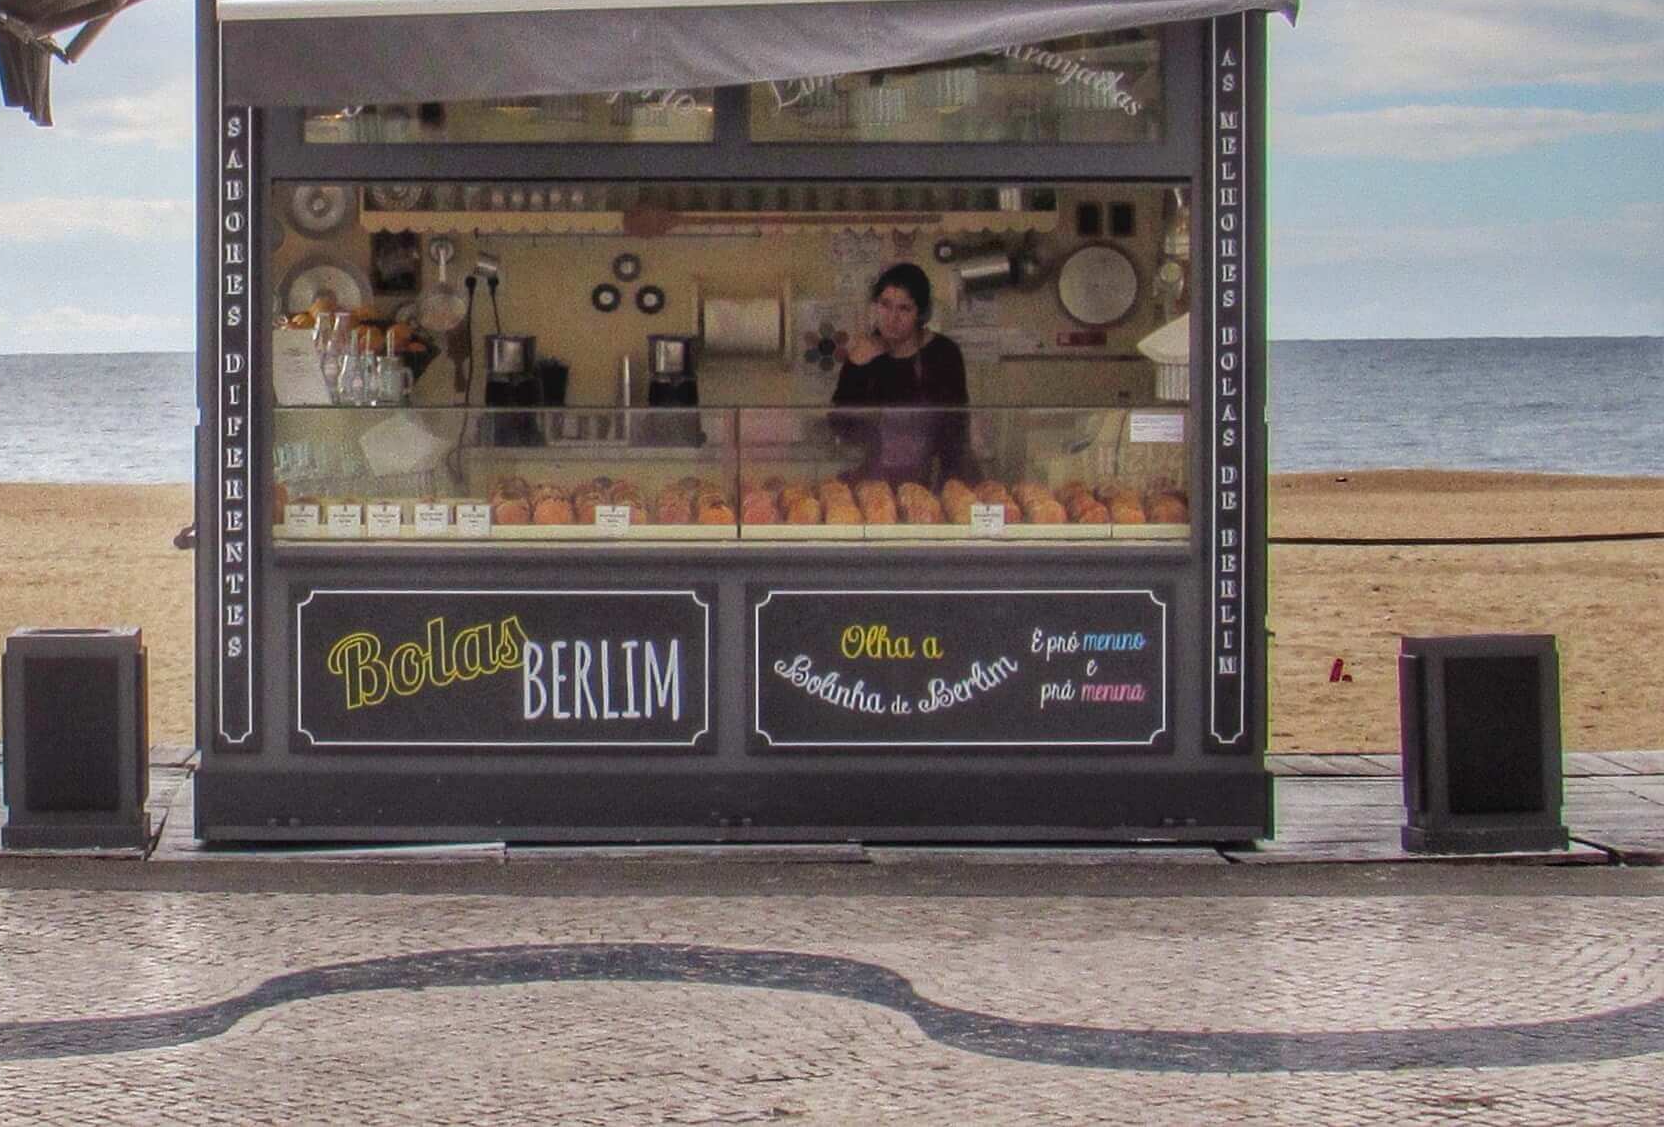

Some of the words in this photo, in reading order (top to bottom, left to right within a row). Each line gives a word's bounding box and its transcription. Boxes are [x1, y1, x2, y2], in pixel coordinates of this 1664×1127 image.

[1219, 48, 1237, 92] AS
[224, 115, 245, 327] SABORES
[1219, 110, 1238, 308] MELHORES
[1219, 326, 1238, 447] BOLAS
[224, 352, 245, 658] DIFERENTES
[1220, 465, 1238, 510] DE
[1218, 528, 1238, 675] BERLIM
[328, 615, 530, 710] Bolas
[522, 638, 680, 721] BERLIM
[841, 625, 915, 660] Olha
[922, 635, 944, 659] a
[1046, 631, 1080, 662] pró
[1083, 631, 1147, 652] menino
[1086, 658, 1098, 676] e
[774, 654, 886, 714] Bolinha
[891, 694, 913, 715] de
[918, 655, 1018, 713] Berlim
[1040, 678, 1076, 709] prá
[1080, 683, 1148, 703] menina
